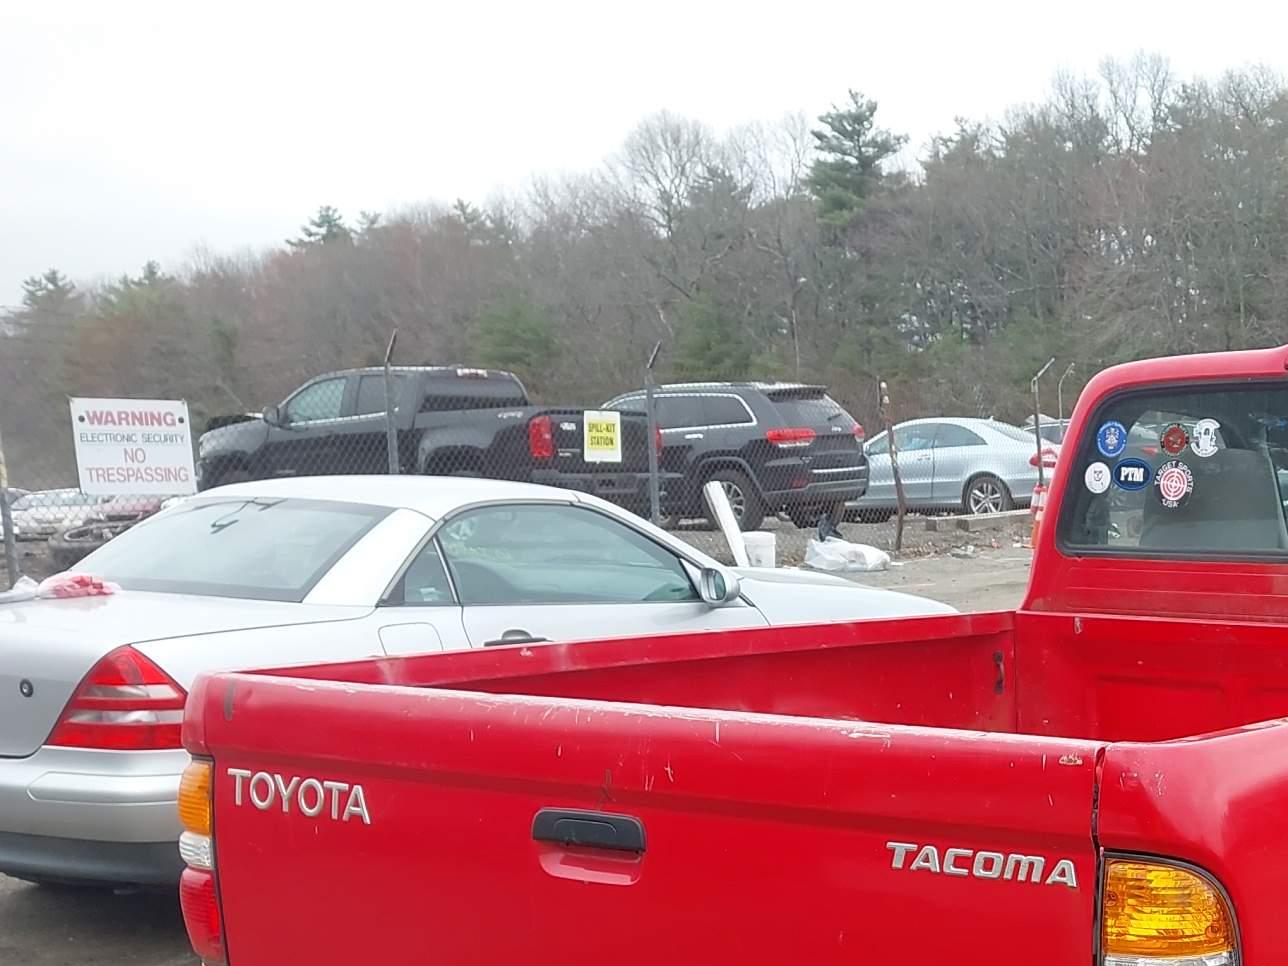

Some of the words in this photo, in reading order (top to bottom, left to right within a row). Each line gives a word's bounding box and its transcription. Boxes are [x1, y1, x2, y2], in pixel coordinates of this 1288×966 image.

[85, 410, 177, 427] WARNING
[588, 423, 616, 433] SPILL-KIT
[80, 432, 138, 443] ELECTRONIC
[141, 432, 184, 443] SECURITY
[590, 436, 614, 446] STATION
[123, 447, 147, 463] NO
[86, 466, 189, 483] TRESPASSING
[1154, 460, 1177, 486] TARGET
[227, 767, 371, 825] TOYOTA
[886, 842, 1077, 888] TACOMA
